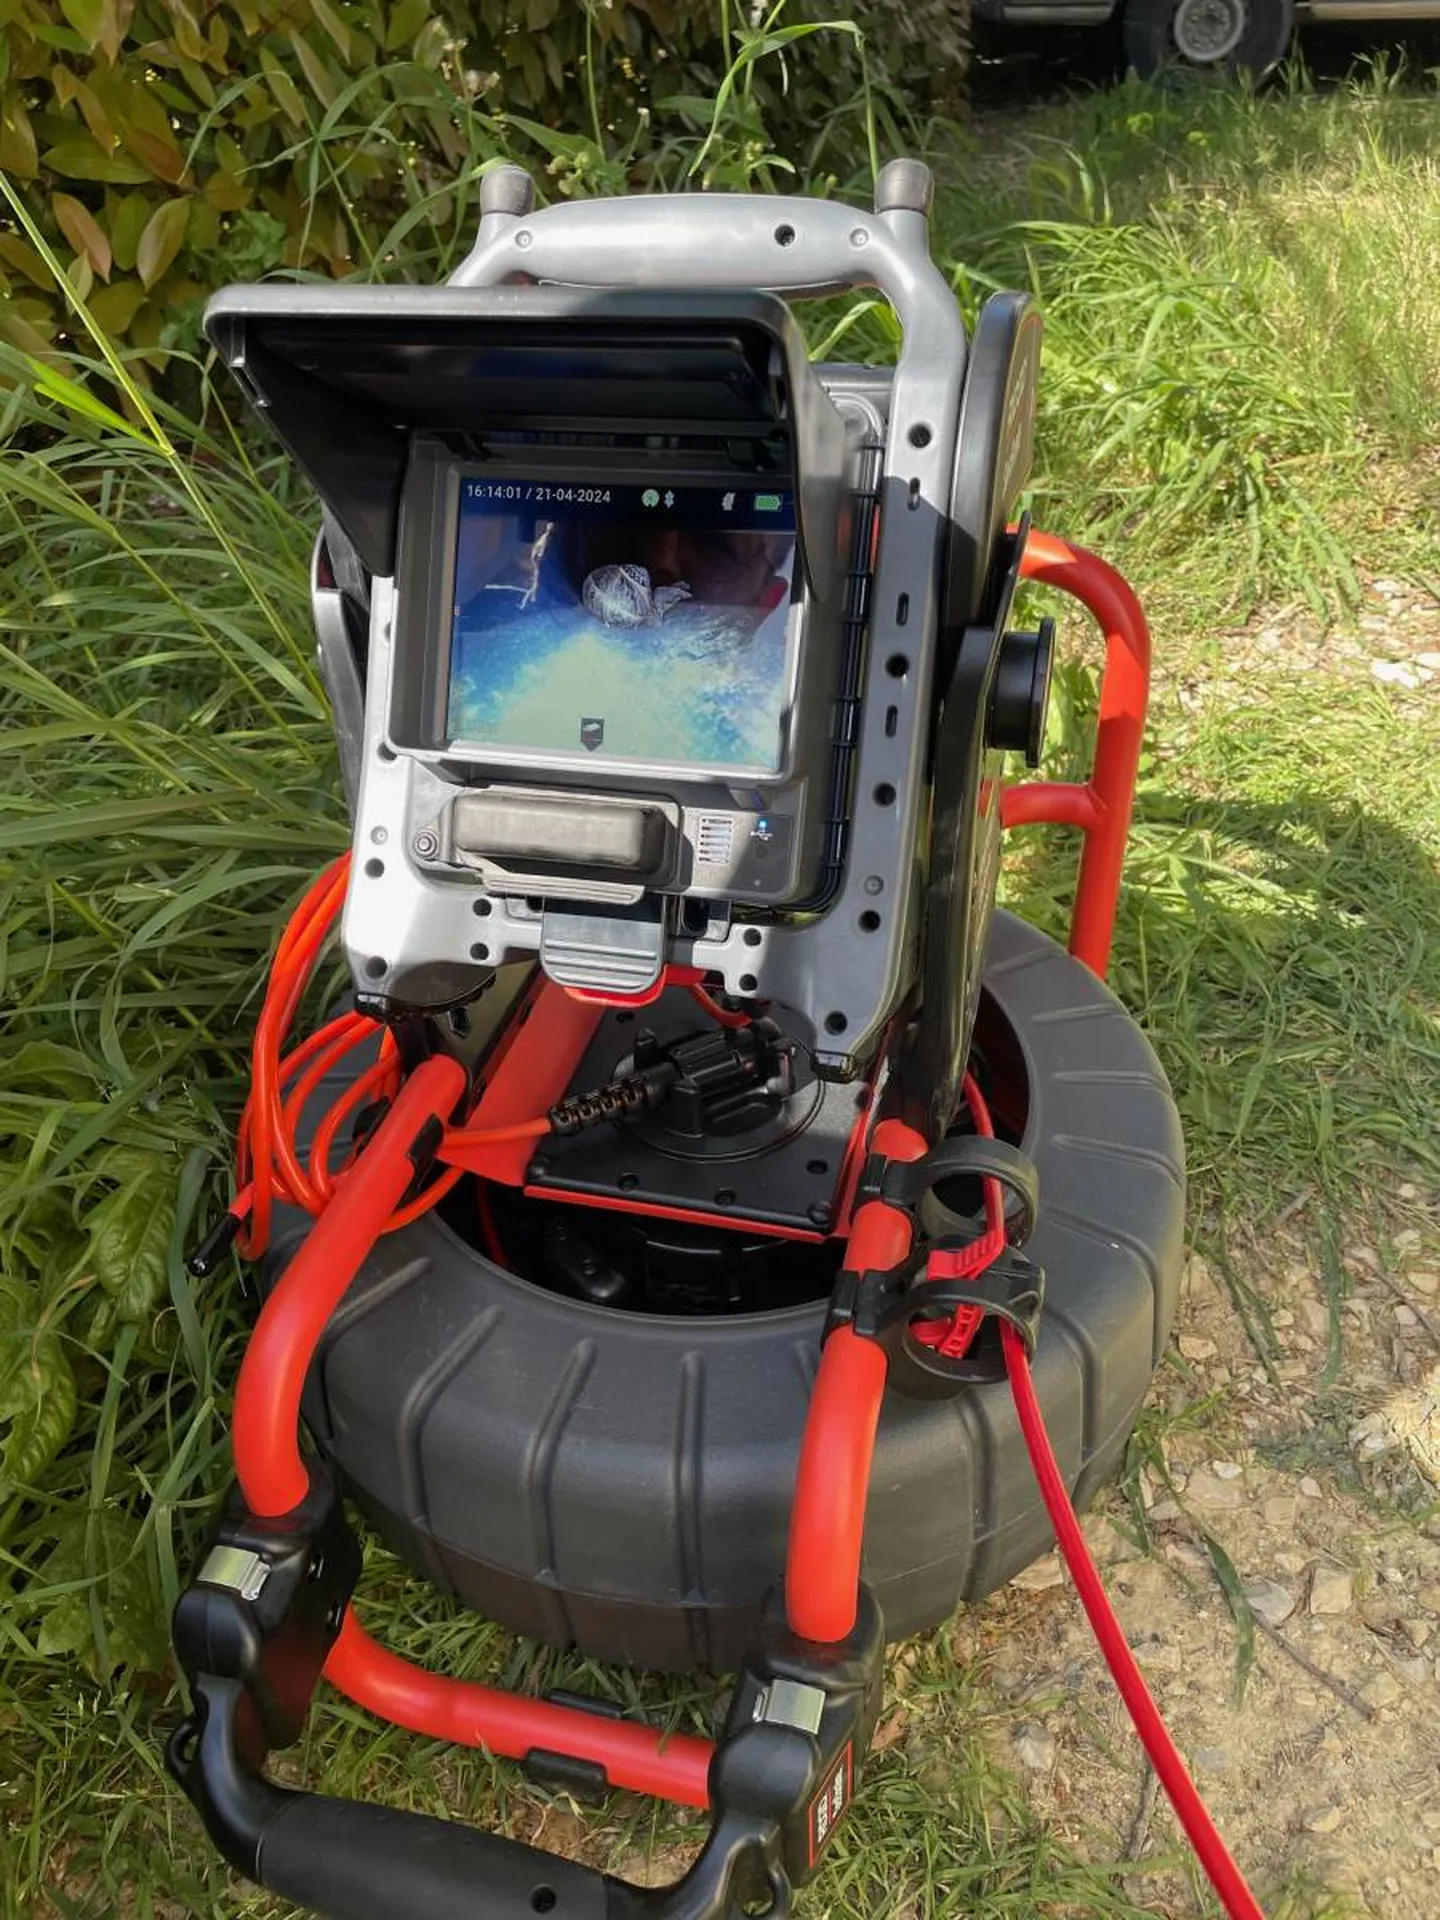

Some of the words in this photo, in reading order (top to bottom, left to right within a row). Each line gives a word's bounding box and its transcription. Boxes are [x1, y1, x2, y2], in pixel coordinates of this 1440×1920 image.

[467, 484, 521, 499] 16:14:01
[525, 487, 532, 500] /
[535, 487, 611, 503] 21-04-2024
